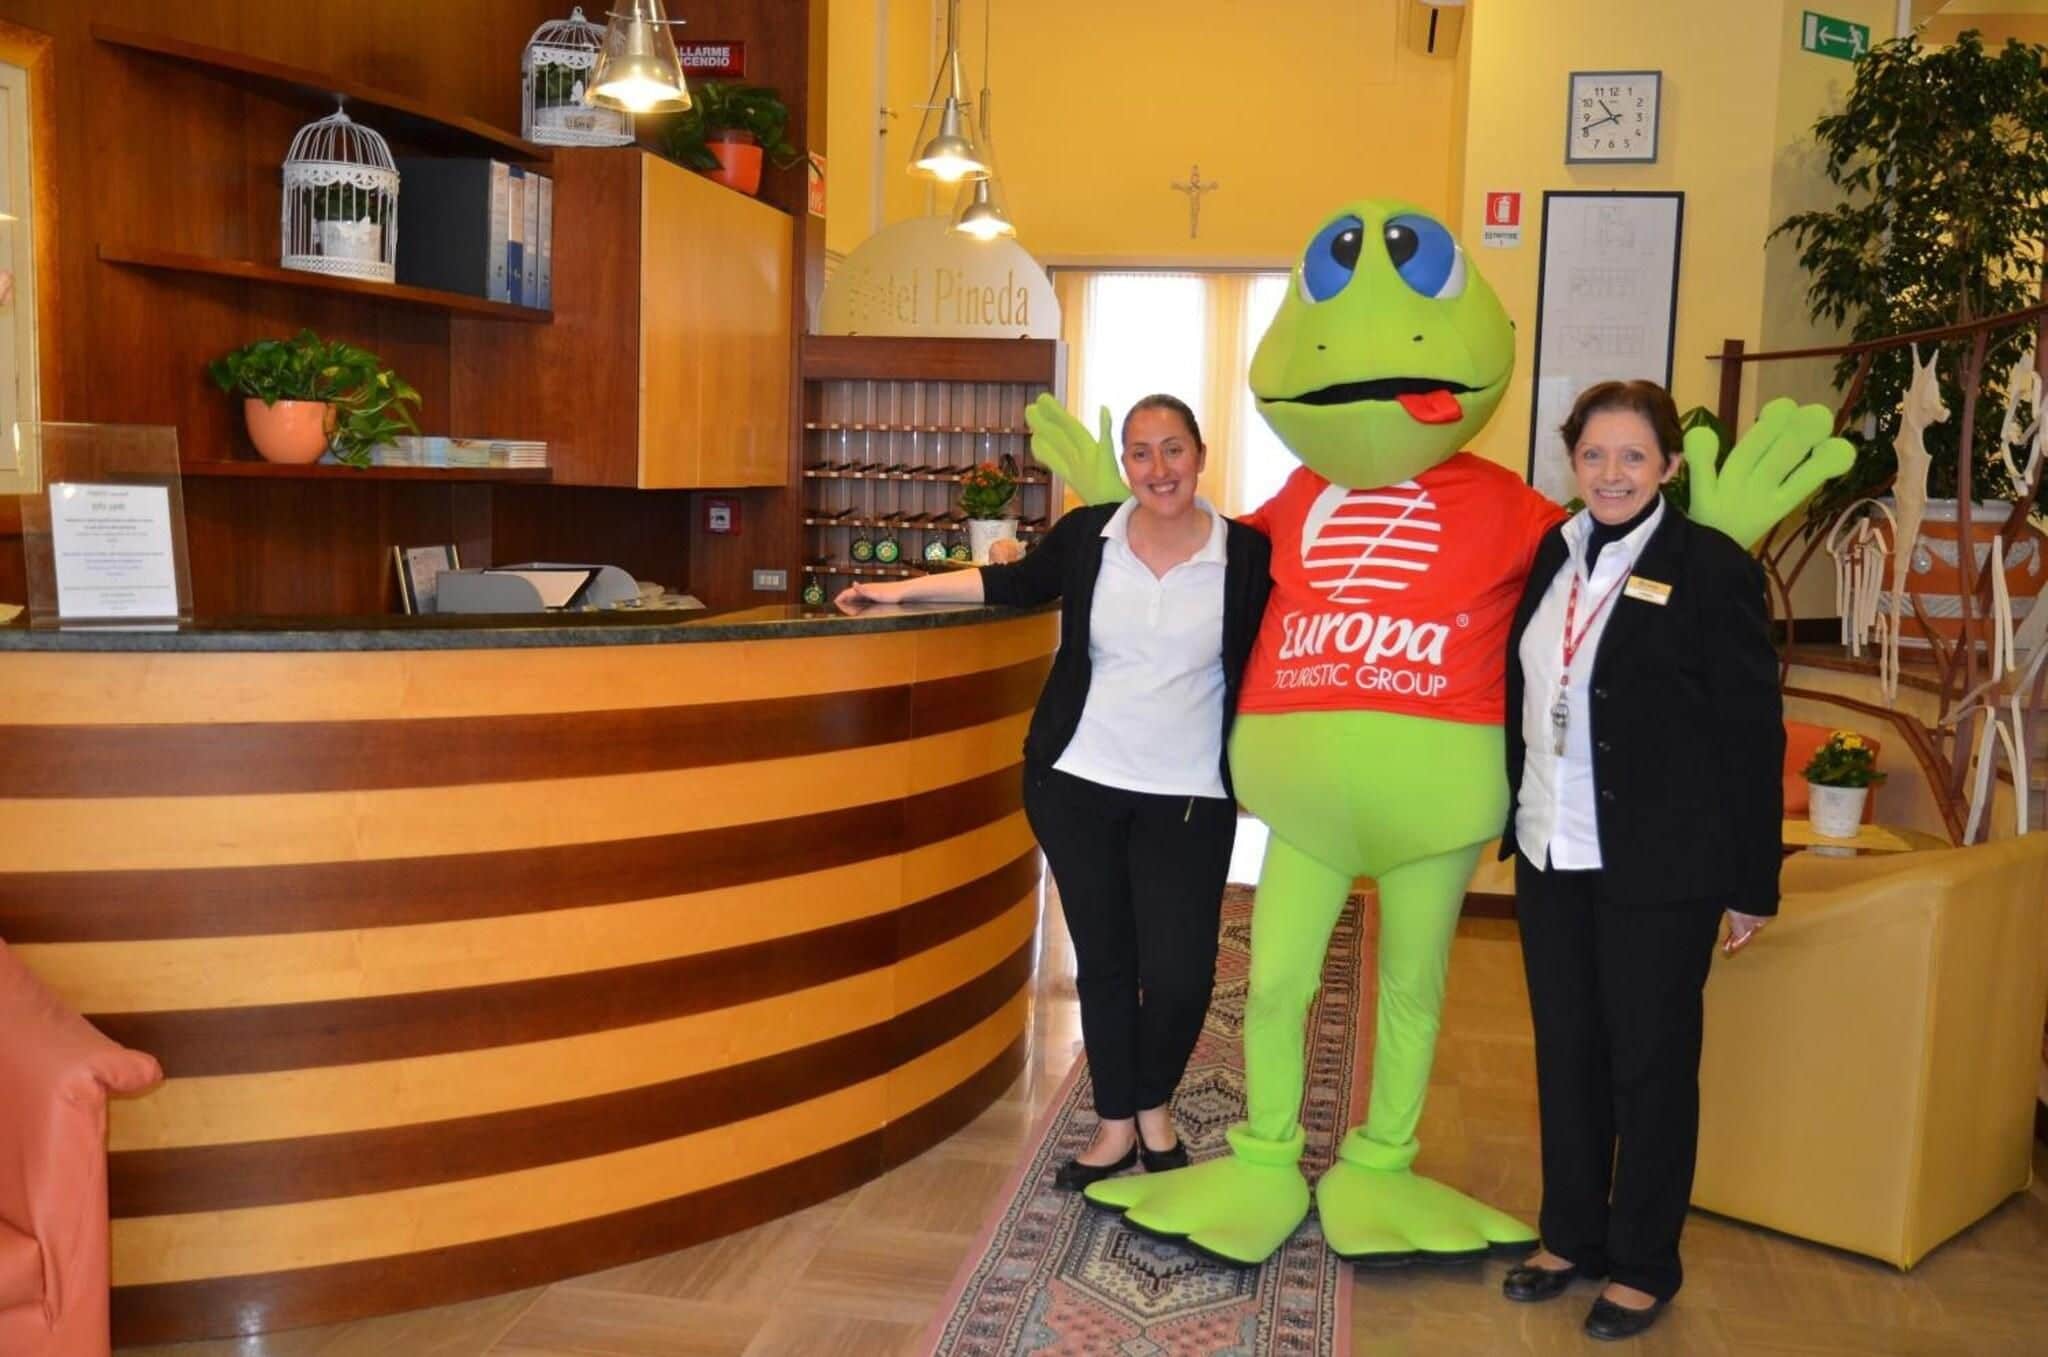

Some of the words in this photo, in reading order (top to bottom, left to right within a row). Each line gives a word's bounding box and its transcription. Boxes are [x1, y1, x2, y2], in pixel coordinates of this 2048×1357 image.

[678, 46, 731, 57] LLARME
[681, 57, 731, 67] CENDIO
[1594, 87, 1604, 96] 11
[1609, 87, 1620, 96] 12
[1636, 97, 1644, 107] 2
[1583, 113, 1591, 122] 9
[1594, 139, 1600, 149] 7
[1608, 140, 1615, 149] 6
[934, 267, 1030, 327] Pineda
[1278, 610, 1451, 665] Europa
[1272, 663, 1350, 689] TOURISTIC
[1355, 665, 1447, 697] GROUP
